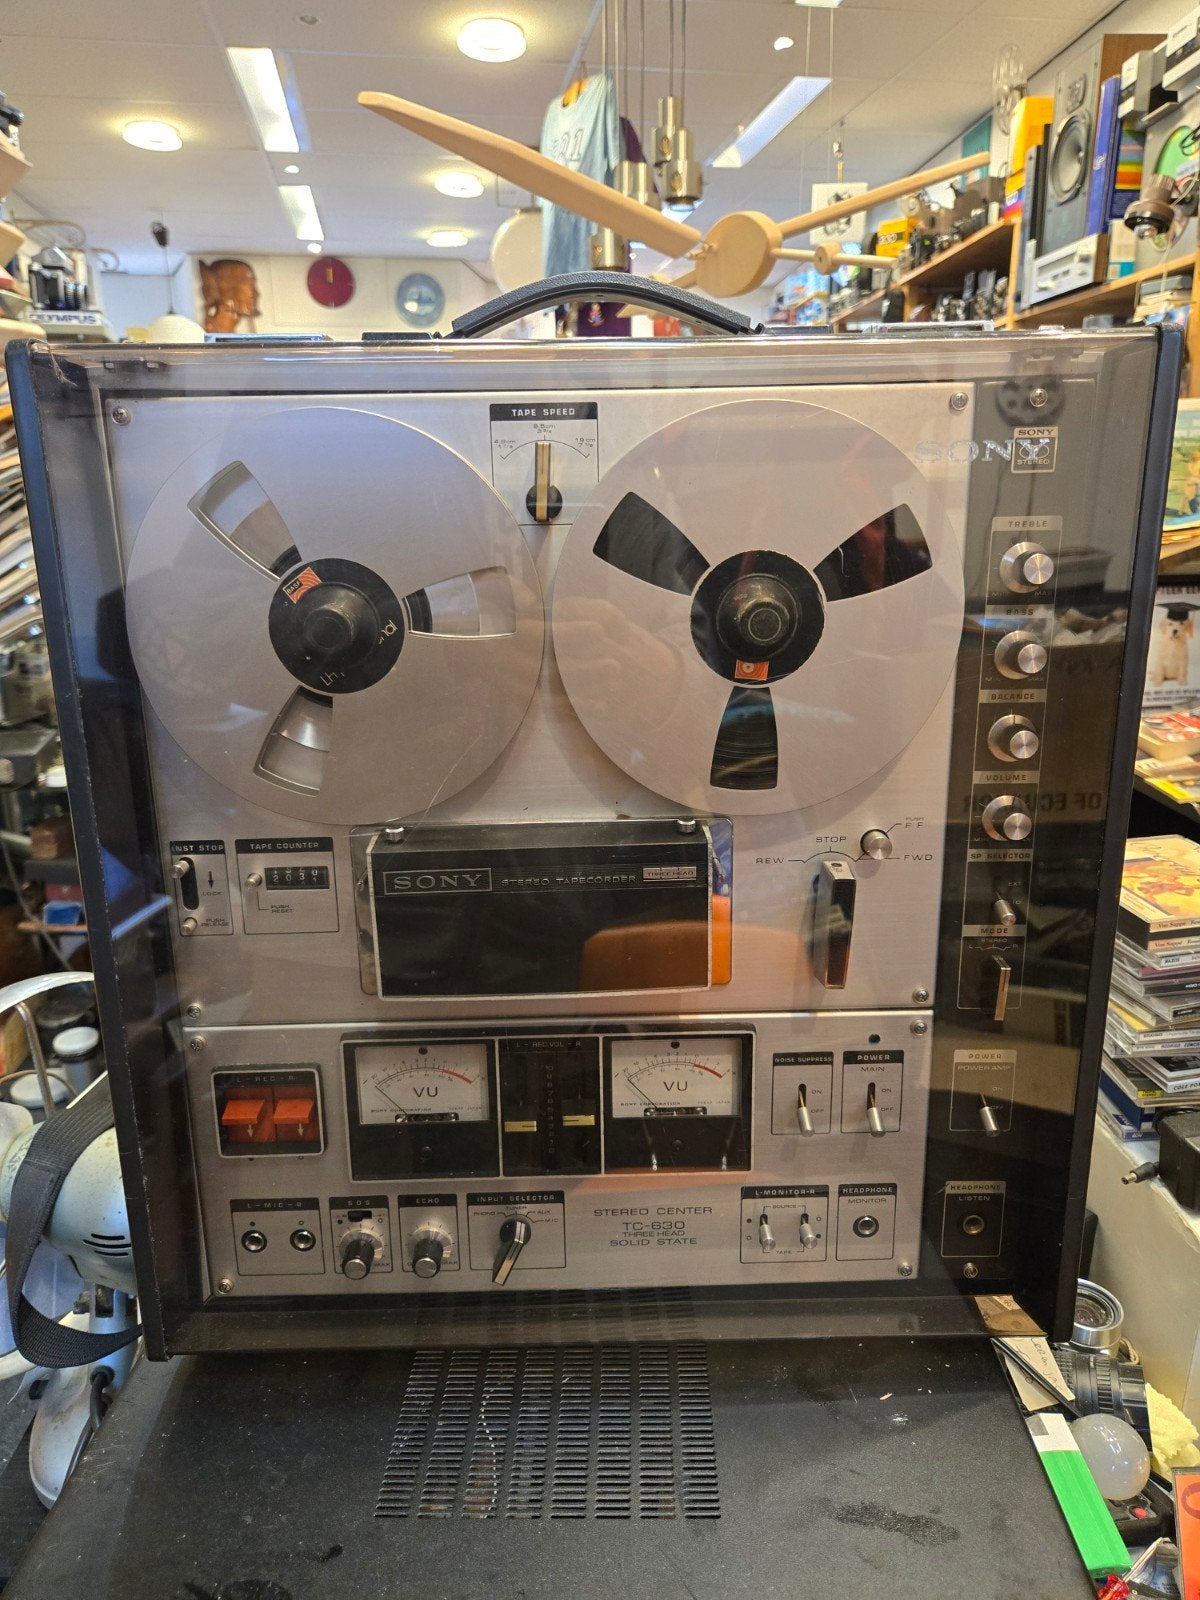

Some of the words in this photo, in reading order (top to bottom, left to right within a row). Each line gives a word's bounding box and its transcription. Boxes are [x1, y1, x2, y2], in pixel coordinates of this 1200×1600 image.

[512, 409, 537, 417] TAPE
[543, 408, 575, 416] SPEED
[914, 438, 1050, 464] SONY
[1008, 520, 1048, 528] TREBLE
[1006, 608, 1034, 616] BASS
[276, 842, 319, 850] COUNTER
[393, 875, 482, 890] SONY
[501, 878, 550, 886] STEREO
[555, 875, 636, 885] TAPECORDER
[663, 1081, 689, 1092] VU
[413, 1086, 439, 1098] VU
[842, 1186, 893, 1194] HEADPHONE
[593, 1208, 649, 1217] STEREO
[656, 1206, 713, 1215] CENTER
[622, 1220, 685, 1231] TC-630
[622, 1230, 655, 1238] THREE
[609, 1239, 650, 1247] SOLID
[656, 1237, 698, 1246] STATE
